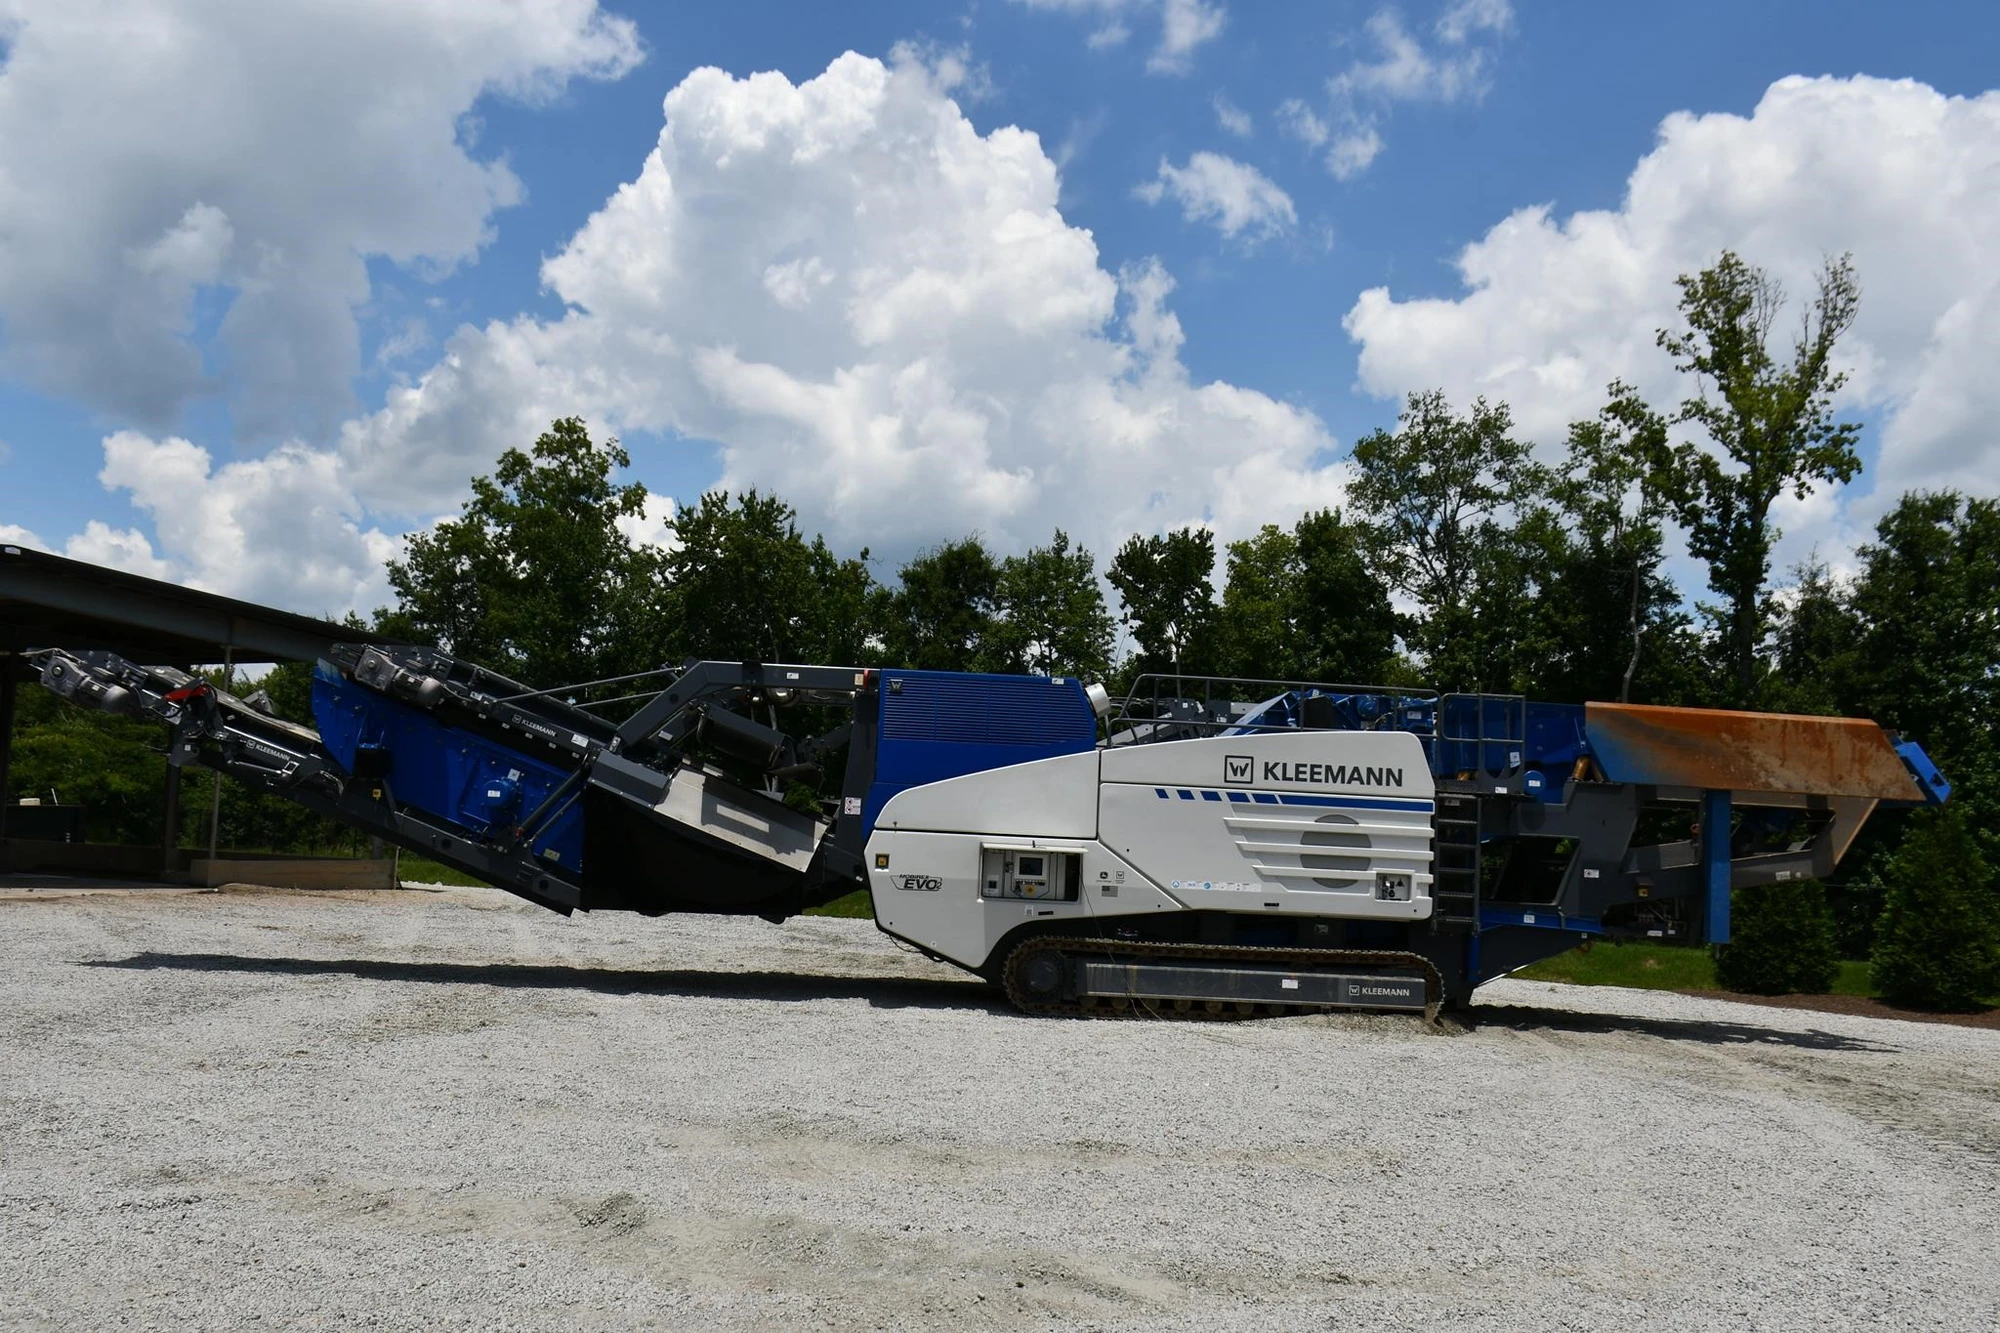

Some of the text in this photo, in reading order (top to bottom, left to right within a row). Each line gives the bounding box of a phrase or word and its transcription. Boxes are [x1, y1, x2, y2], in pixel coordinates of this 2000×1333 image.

[521, 719, 557, 737] KLEEMANN
[255, 744, 290, 761] KLEEMANN
[1263, 761, 1403, 787] KLEEMANN
[1362, 987, 1410, 997] KLEEMANN
